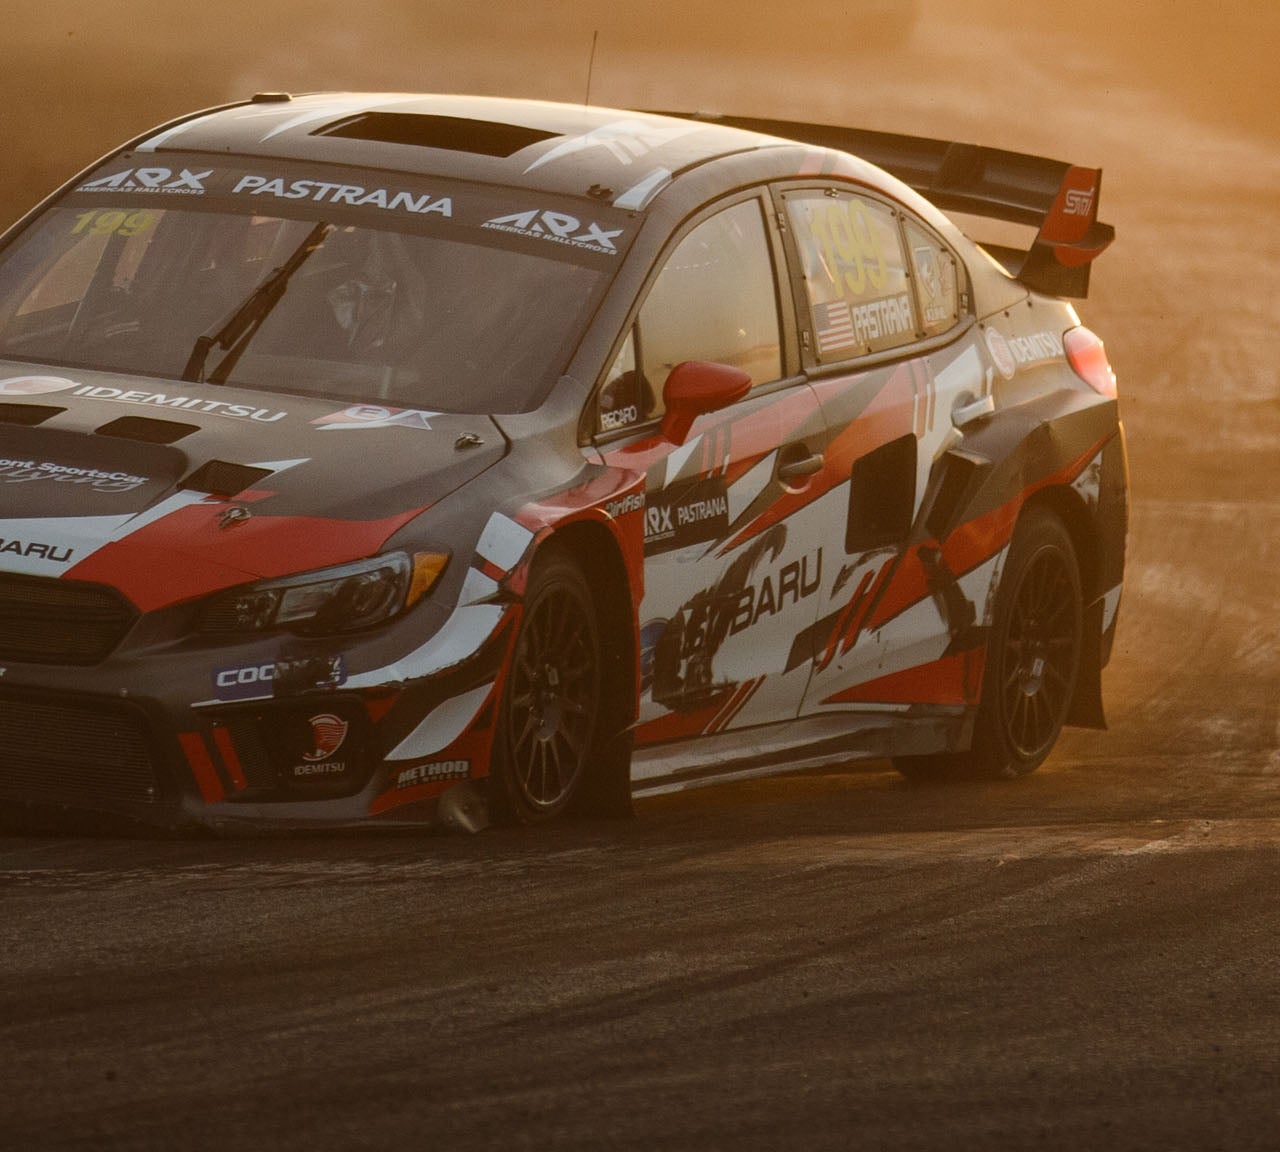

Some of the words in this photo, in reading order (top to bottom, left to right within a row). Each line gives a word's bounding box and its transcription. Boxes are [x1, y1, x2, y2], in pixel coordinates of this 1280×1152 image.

[83, 167, 214, 189] ARX
[232, 175, 452, 217] PASTRANA
[69, 210, 156, 237] 199
[480, 222, 542, 238] AMERICAS
[543, 234, 618, 255] RALLYCROSS
[486, 209, 624, 249] ARX
[810, 199, 886, 298] 199
[852, 295, 914, 346] PASTRANA
[72, 386, 288, 422] IDEMITSU
[601, 405, 637, 431] RECARO
[38, 462, 149, 484] SportsCar
[678, 496, 728, 526] PASTRANA
[294, 762, 345, 776] IDEMITSU
[398, 760, 469, 784] METHOD
